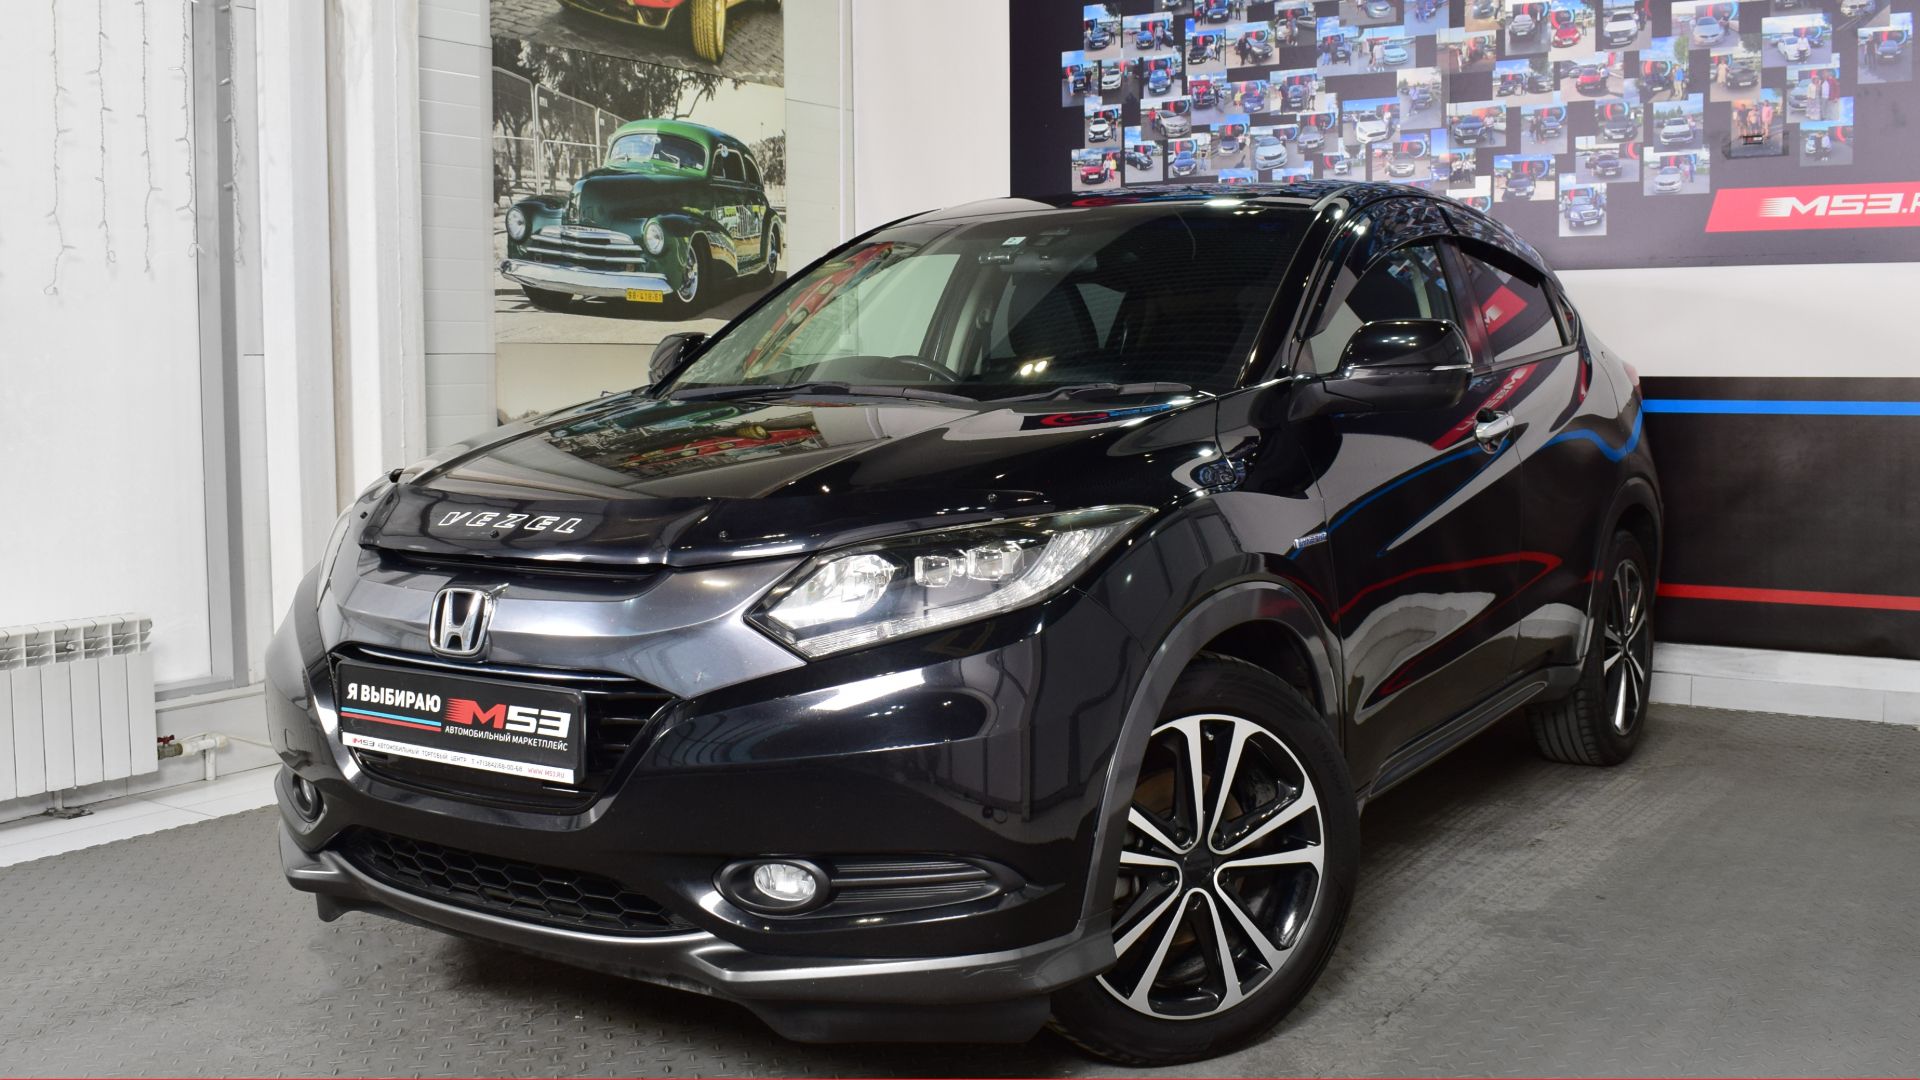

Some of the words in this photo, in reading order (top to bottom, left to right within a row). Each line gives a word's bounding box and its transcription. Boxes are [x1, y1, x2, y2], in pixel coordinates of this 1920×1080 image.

[438, 511, 583, 534] VEZEL
[347, 683, 358, 700] Я
[361, 685, 441, 713] ВЫБИРАЮ
[446, 698, 571, 738] M53
[445, 726, 511, 743] АВТОМОБИЛЬНЫЙ
[512, 736, 568, 752] МАРКЕТПЛЕЙС
